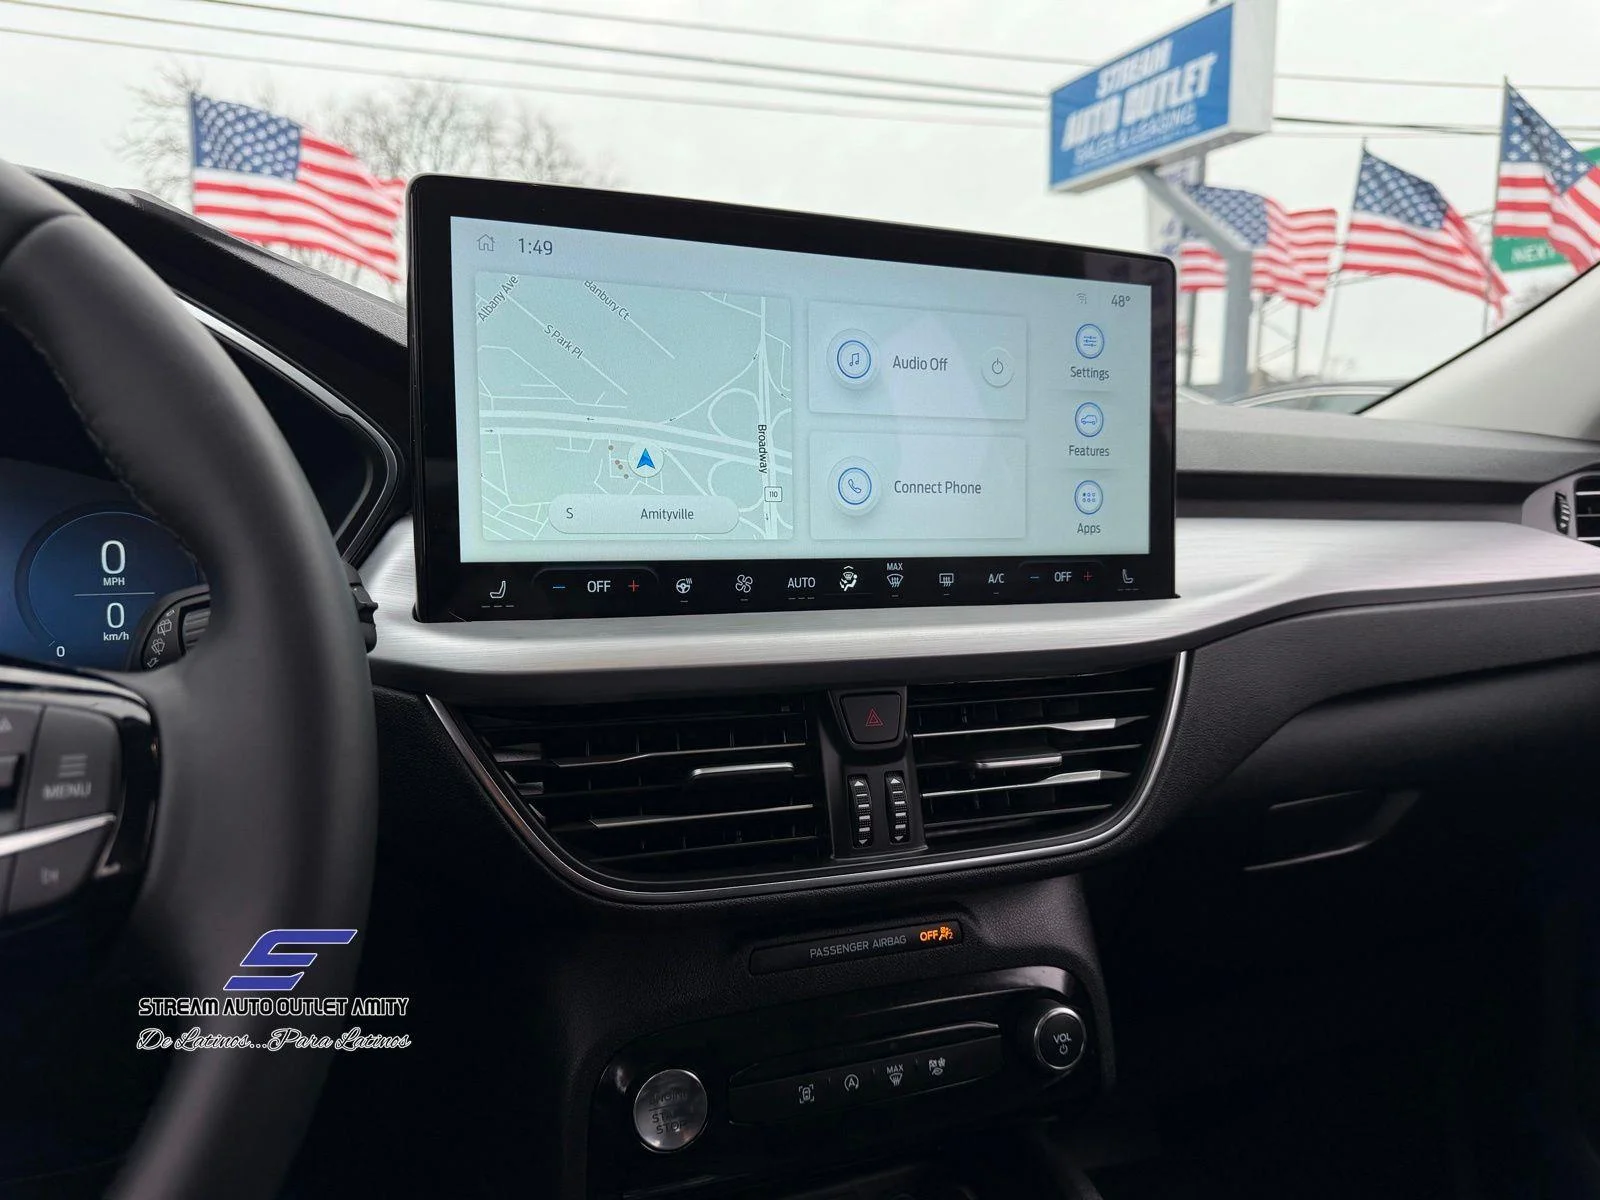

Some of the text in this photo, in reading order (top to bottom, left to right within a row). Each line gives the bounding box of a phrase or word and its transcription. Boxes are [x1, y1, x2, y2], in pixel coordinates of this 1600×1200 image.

[1122, 52, 1217, 126] OUTLET
[517, 237, 553, 256] 1:49
[477, 274, 519, 322] Albany Ave
[1111, 295, 1131, 307] 48°
[615, 307, 630, 321] Ct
[552, 328, 572, 349] Park
[892, 356, 949, 371] Audio Off
[1069, 366, 1110, 380] Settings
[757, 424, 768, 474] Broadway
[1068, 445, 1110, 457] Features
[893, 480, 982, 495] Connect Phone
[565, 507, 695, 522] S Amityville
[1076, 522, 1101, 535] Apps
[100, 540, 126, 575] 0
[886, 562, 904, 571] MAX
[103, 577, 126, 587] MPH
[787, 577, 816, 589] AUTO
[988, 573, 1005, 585] A/C
[1054, 571, 1072, 583] OFF
[587, 580, 612, 594] OFF
[106, 602, 125, 629] 0
[103, 631, 130, 642] km/h
[56, 645, 66, 658] 0
[919, 929, 939, 942] OFF
[809, 934, 907, 959] PASSENGER AIRBAG
[1053, 1032, 1072, 1043] VOL
[886, 1064, 904, 1074] MAX
